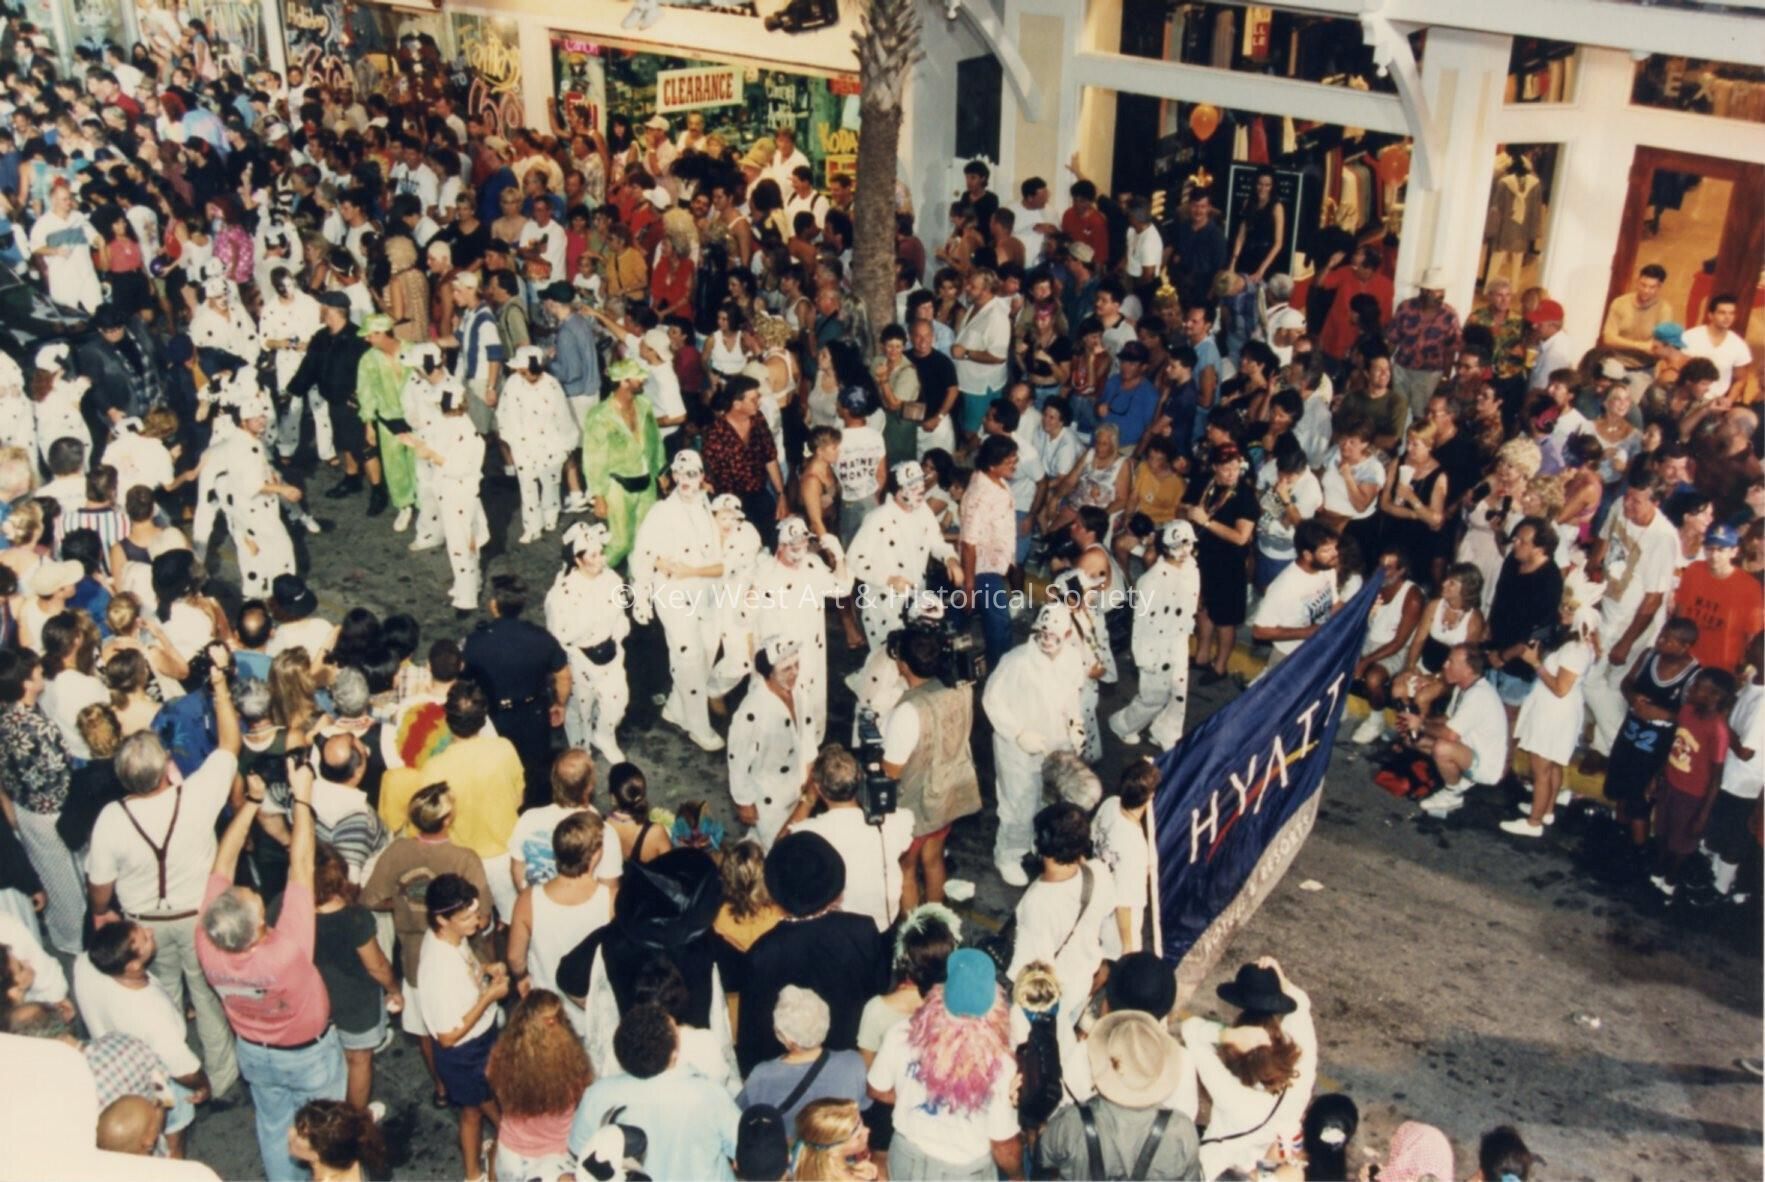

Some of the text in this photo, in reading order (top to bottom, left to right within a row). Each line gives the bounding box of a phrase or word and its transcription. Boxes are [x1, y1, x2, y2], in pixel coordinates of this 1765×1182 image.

[663, 72, 734, 107] CLEARANCE
[1624, 720, 1658, 752] 32
[1190, 672, 1346, 864] HYATT
[1260, 813, 1312, 882] RESORTS
